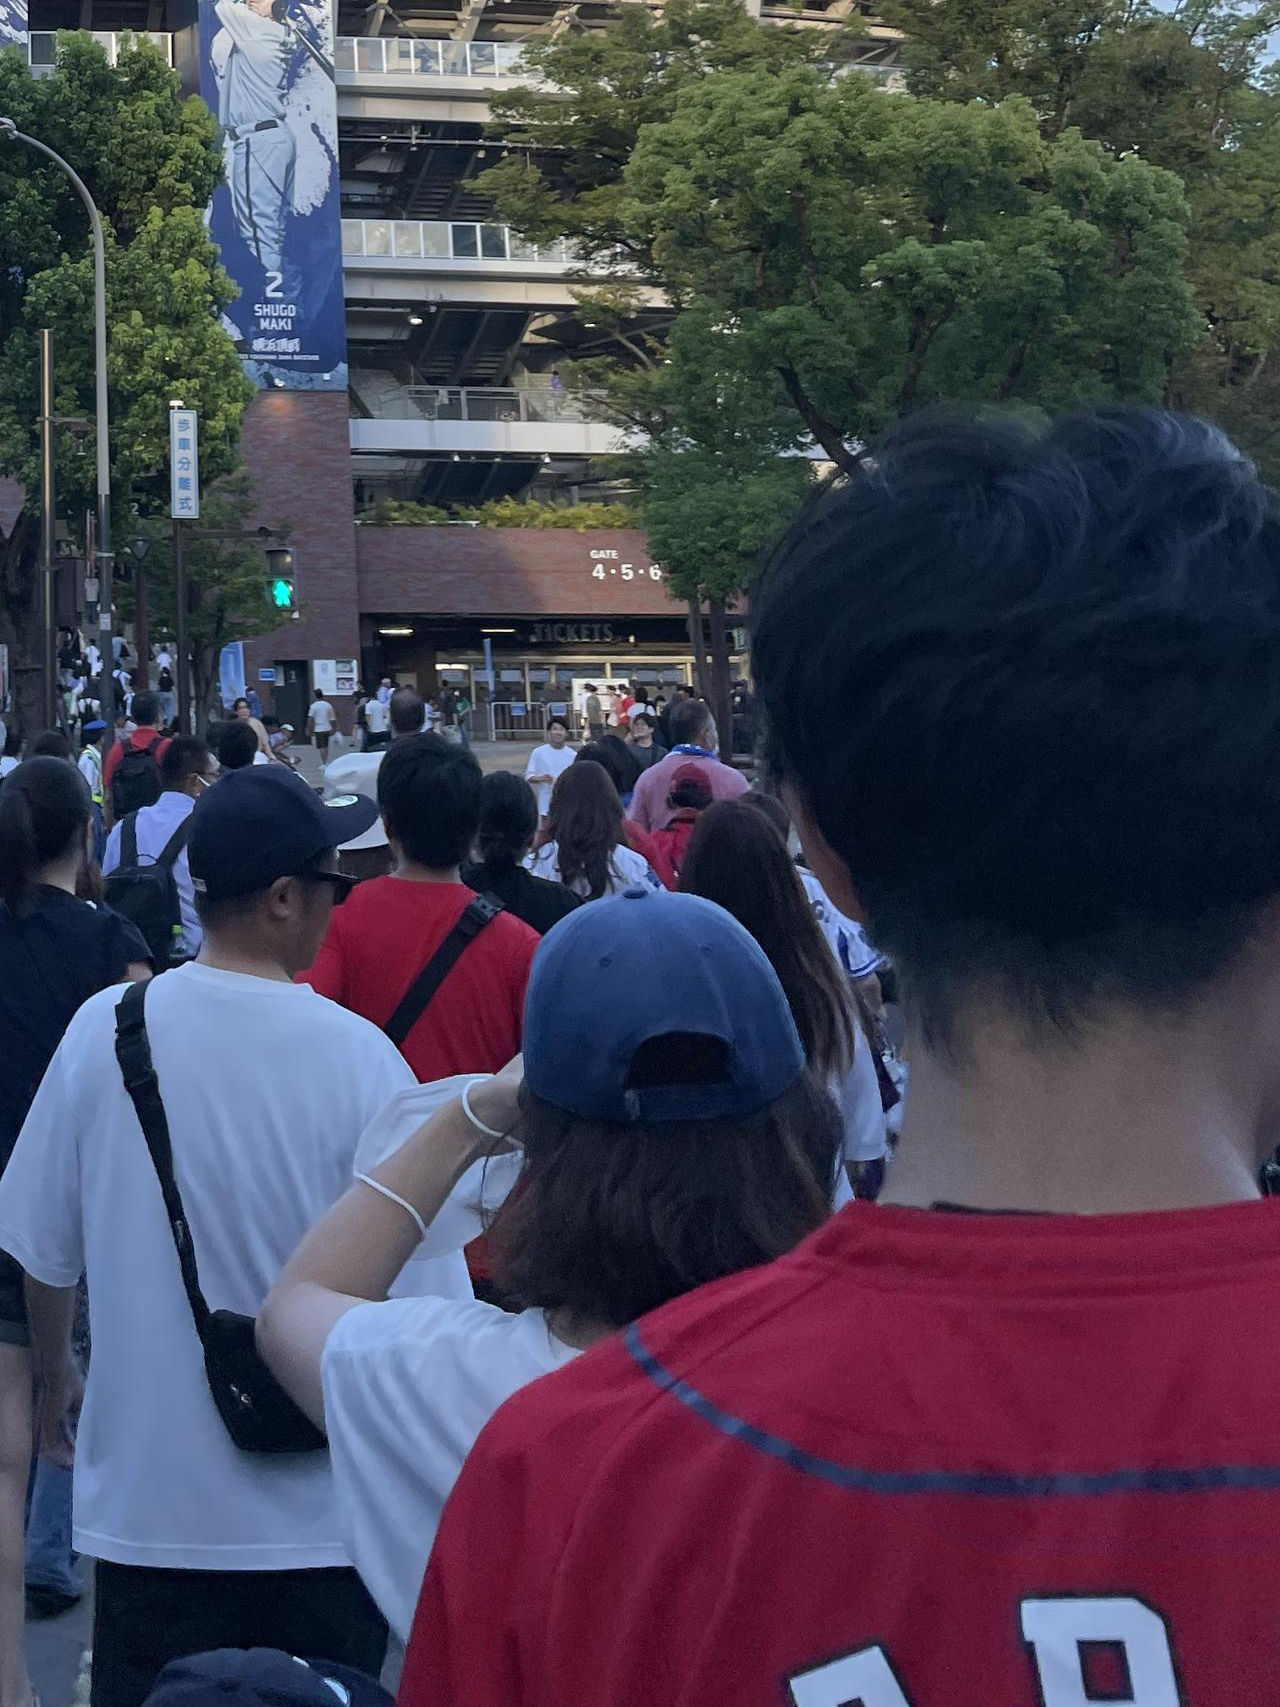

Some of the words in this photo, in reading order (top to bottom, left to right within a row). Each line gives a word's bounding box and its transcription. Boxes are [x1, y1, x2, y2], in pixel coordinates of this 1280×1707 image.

[265, 271, 283, 298] 2
[254, 304, 296, 316] SHUGO
[260, 318, 292, 330] MAKI
[590, 550, 619, 559] GATE
[532, 623, 614, 642] TICKETS
